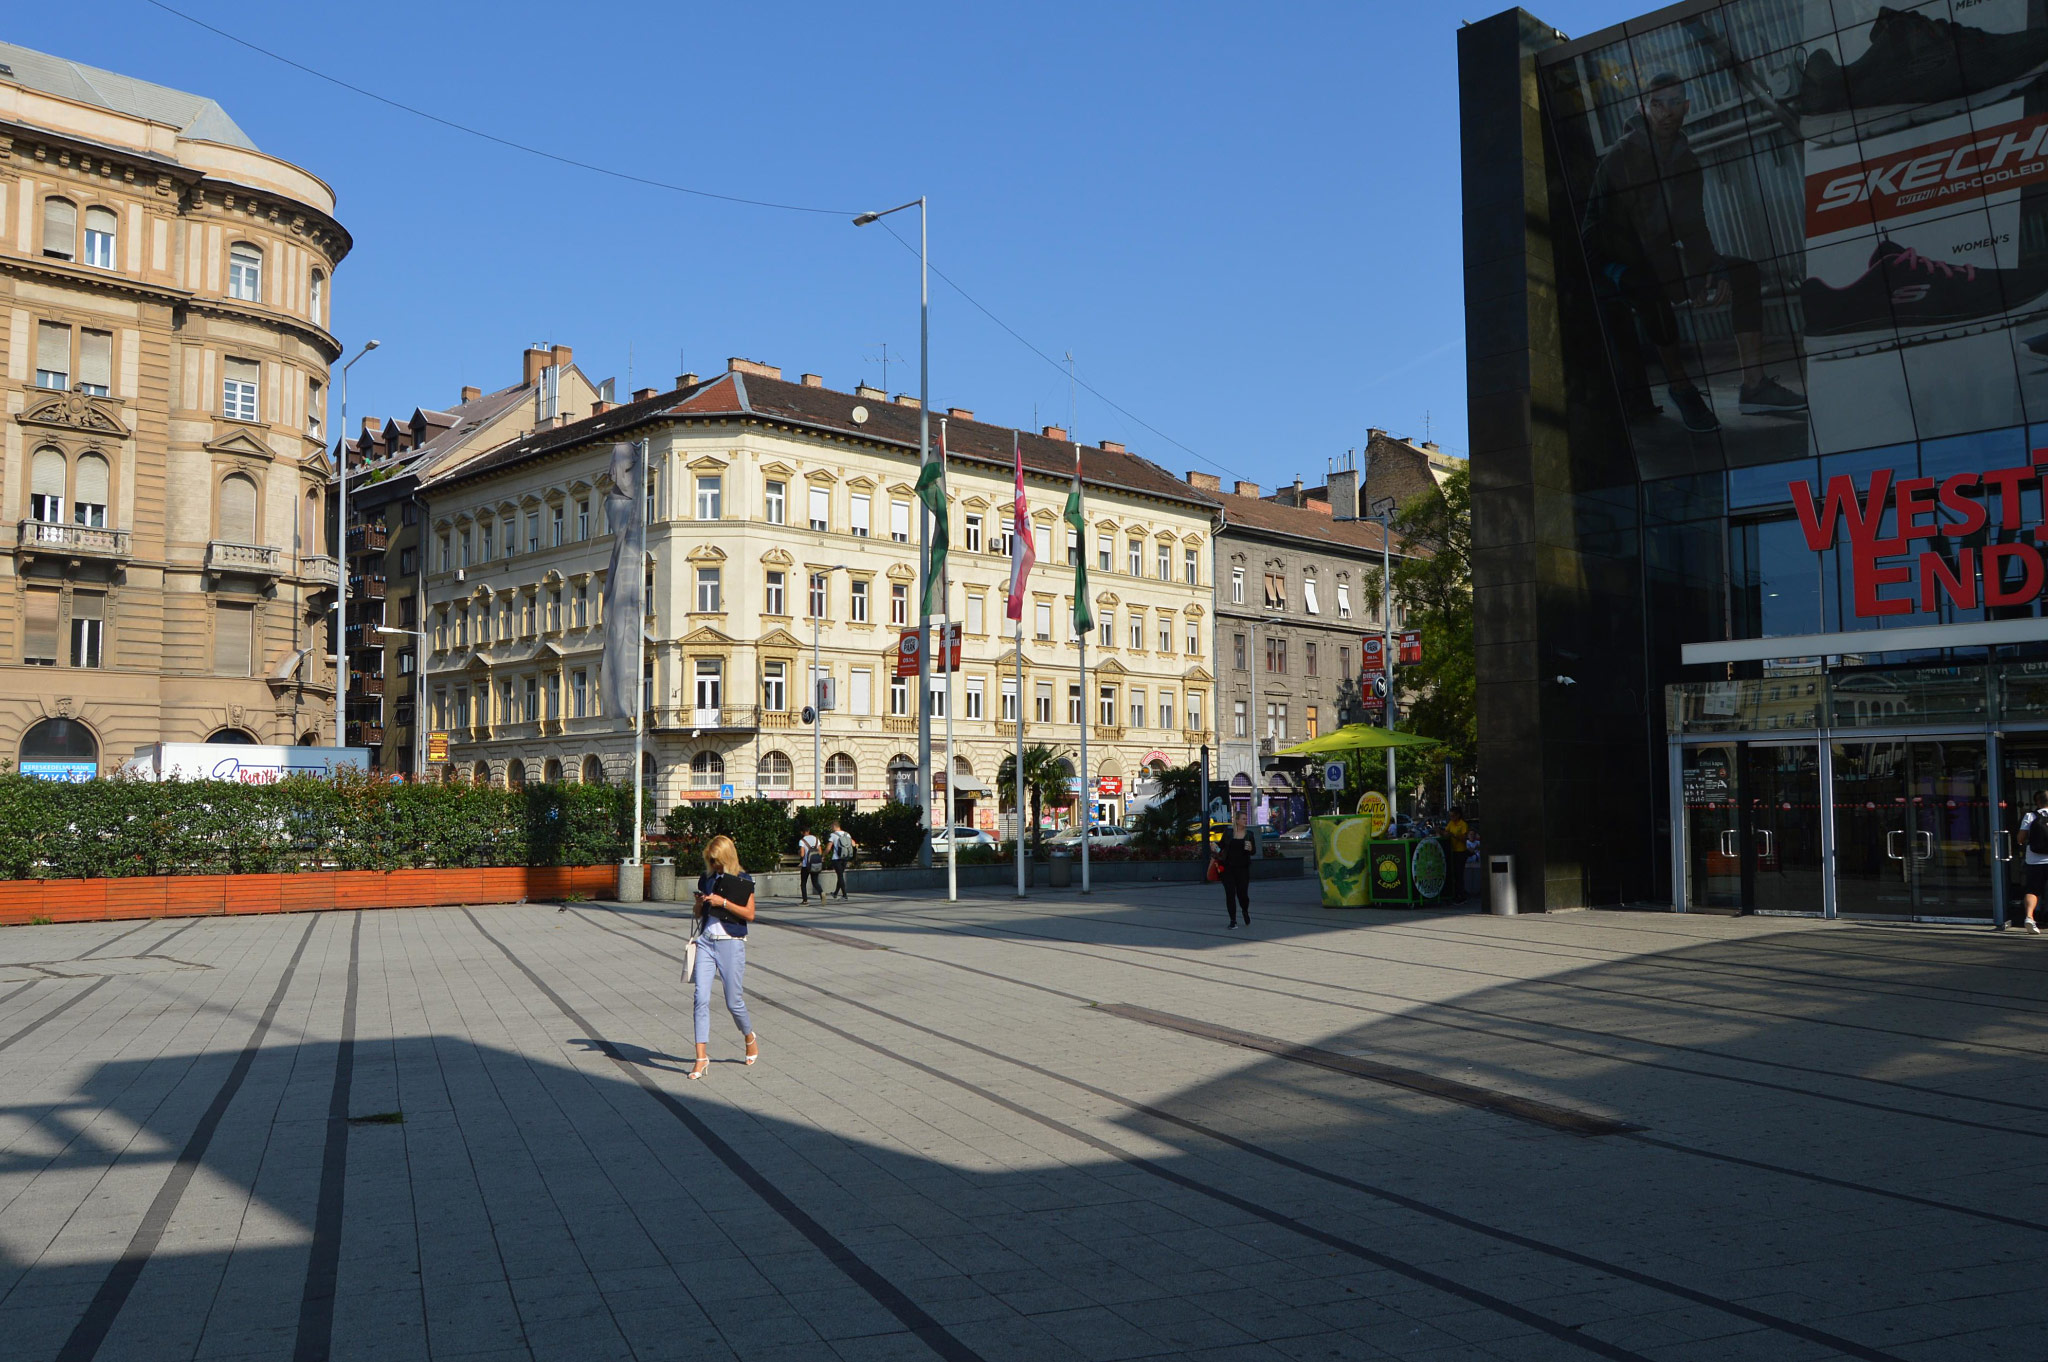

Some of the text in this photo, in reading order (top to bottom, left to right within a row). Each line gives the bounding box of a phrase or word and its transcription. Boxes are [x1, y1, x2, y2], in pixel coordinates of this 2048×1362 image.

[1937, 162, 2045, 197] AIR-COOLED
[1951, 233, 2010, 255] WOMEN'S
[1788, 465, 2036, 552] WEST
[1851, 537, 2045, 617] END
[1357, 802, 1386, 814] MOJITO
[1375, 854, 1401, 865] MOJITO
[1376, 879, 1401, 890] LEMON
